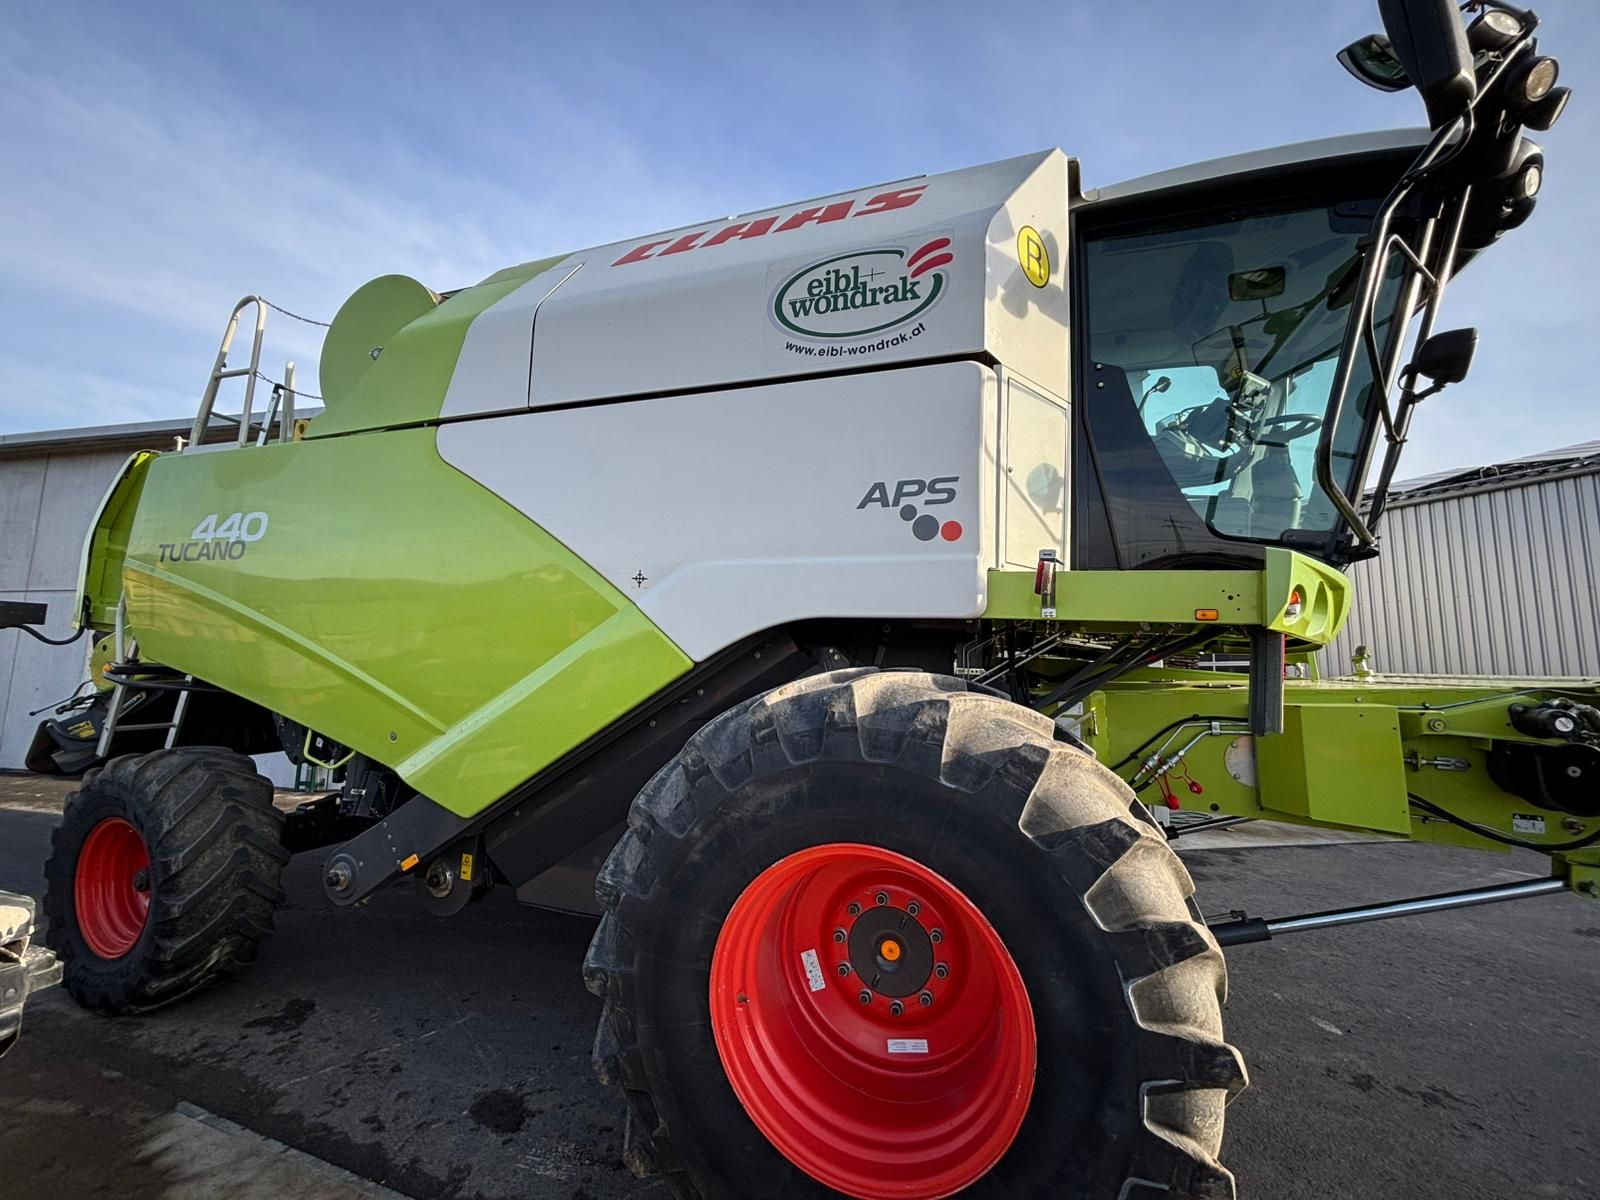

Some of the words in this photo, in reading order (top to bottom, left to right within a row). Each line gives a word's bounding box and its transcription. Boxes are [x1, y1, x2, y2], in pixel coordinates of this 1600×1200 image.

[611, 184, 929, 267] CLAAS
[789, 276, 921, 318] wondrak
[785, 322, 926, 357] www.eibl-wondrak.at
[856, 476, 960, 510] APS
[191, 511, 269, 543] 440
[159, 540, 246, 562] TUCANO
